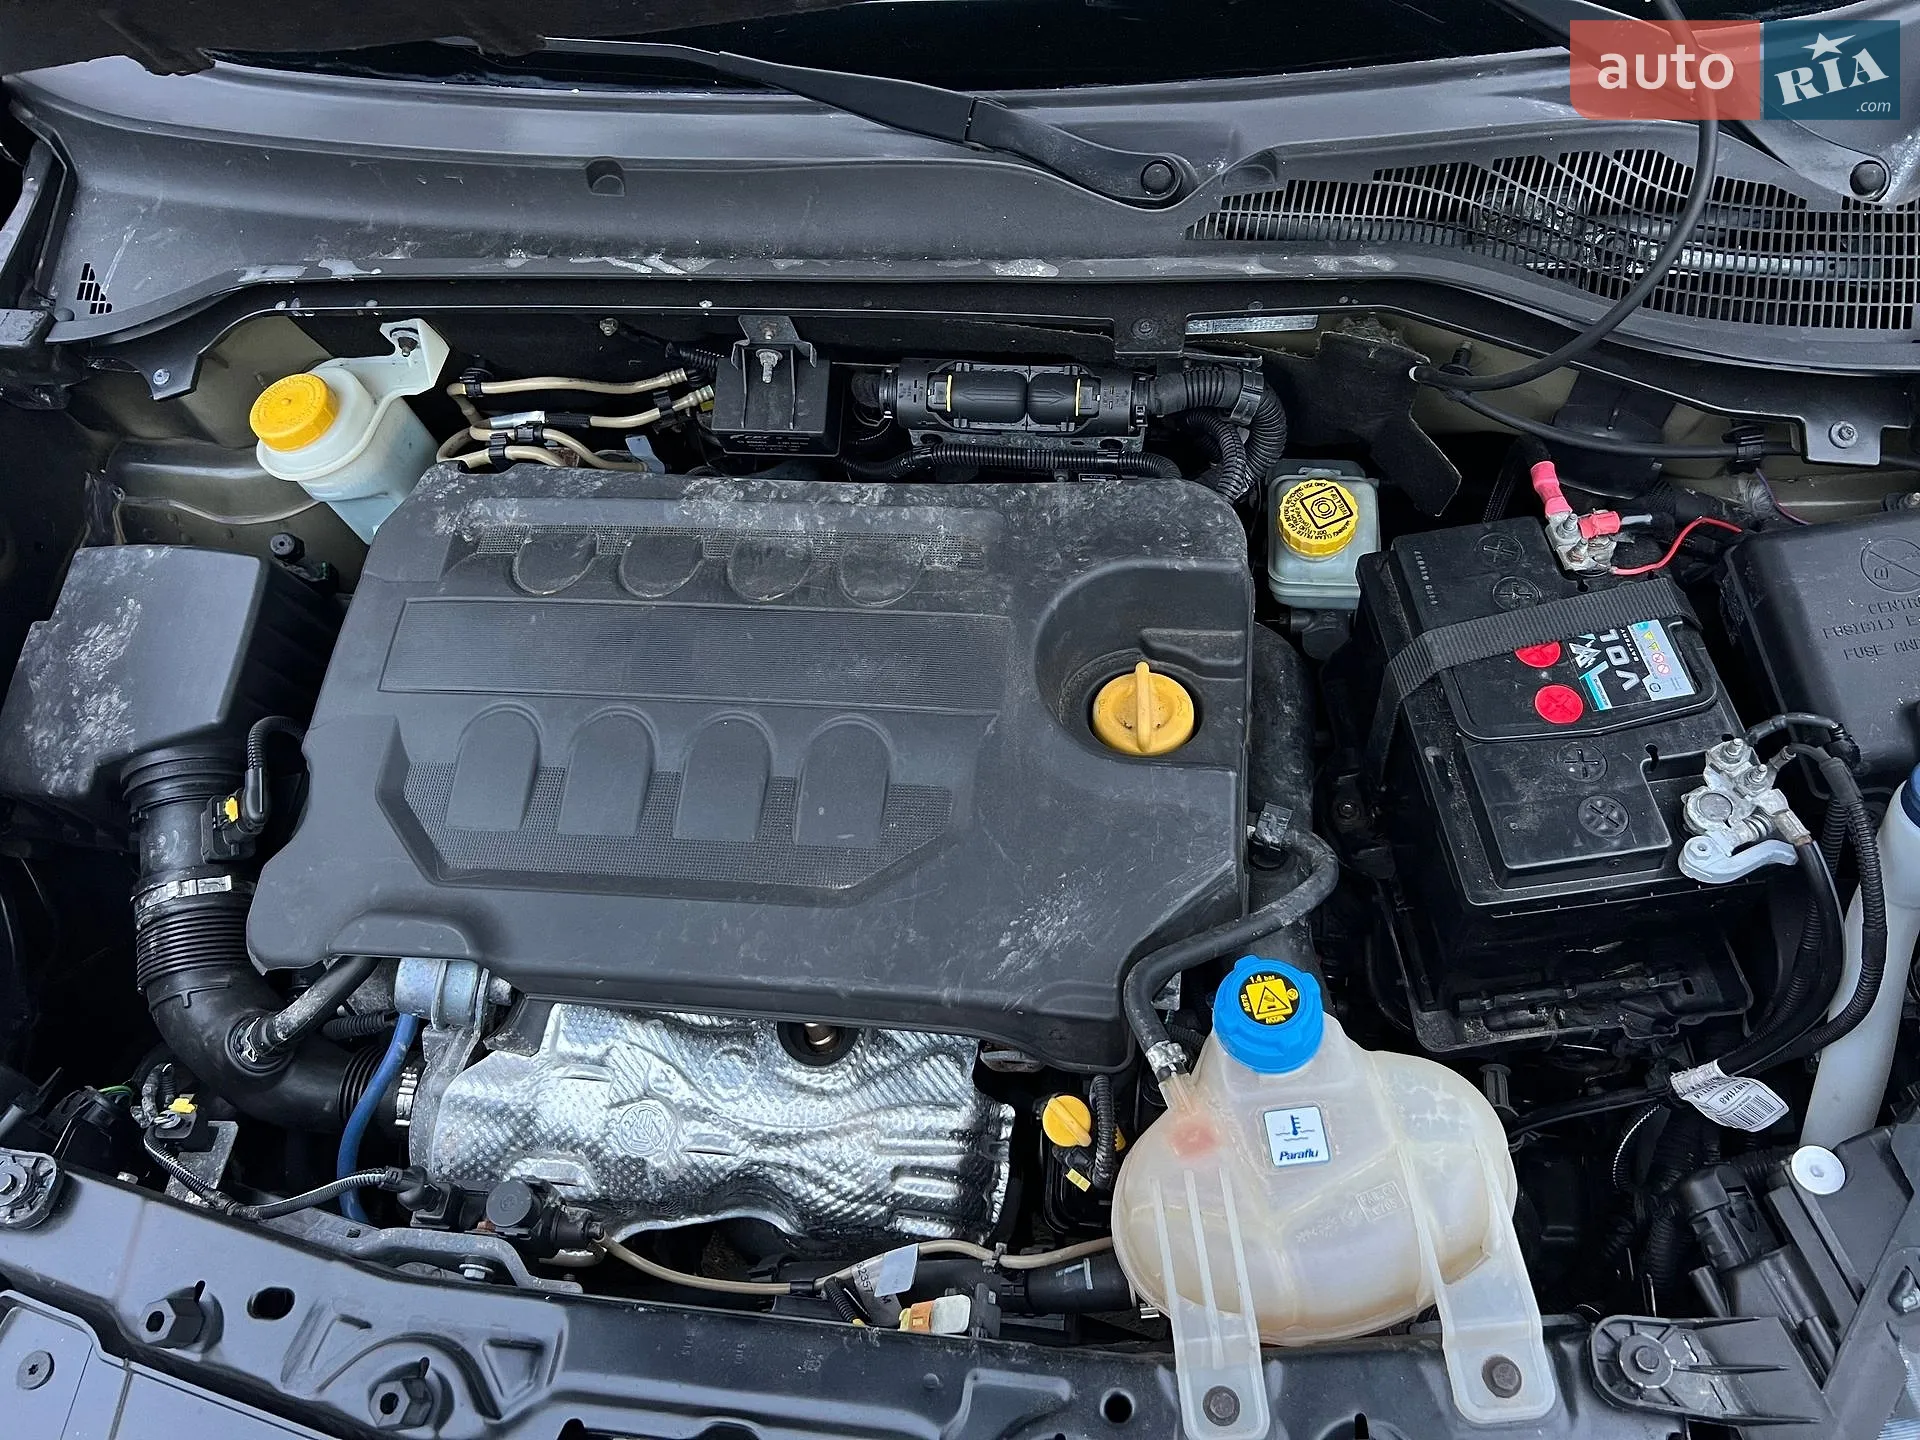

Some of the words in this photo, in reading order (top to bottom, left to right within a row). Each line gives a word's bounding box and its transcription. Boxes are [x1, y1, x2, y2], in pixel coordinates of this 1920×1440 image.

[1868, 596, 1920, 615] CENTR
[1620, 628, 1640, 662] BATTERY
[1844, 644, 1888, 662] FUSE
[1250, 974, 1262, 984] 1.4
[1280, 1148, 1318, 1160] Paraflu
